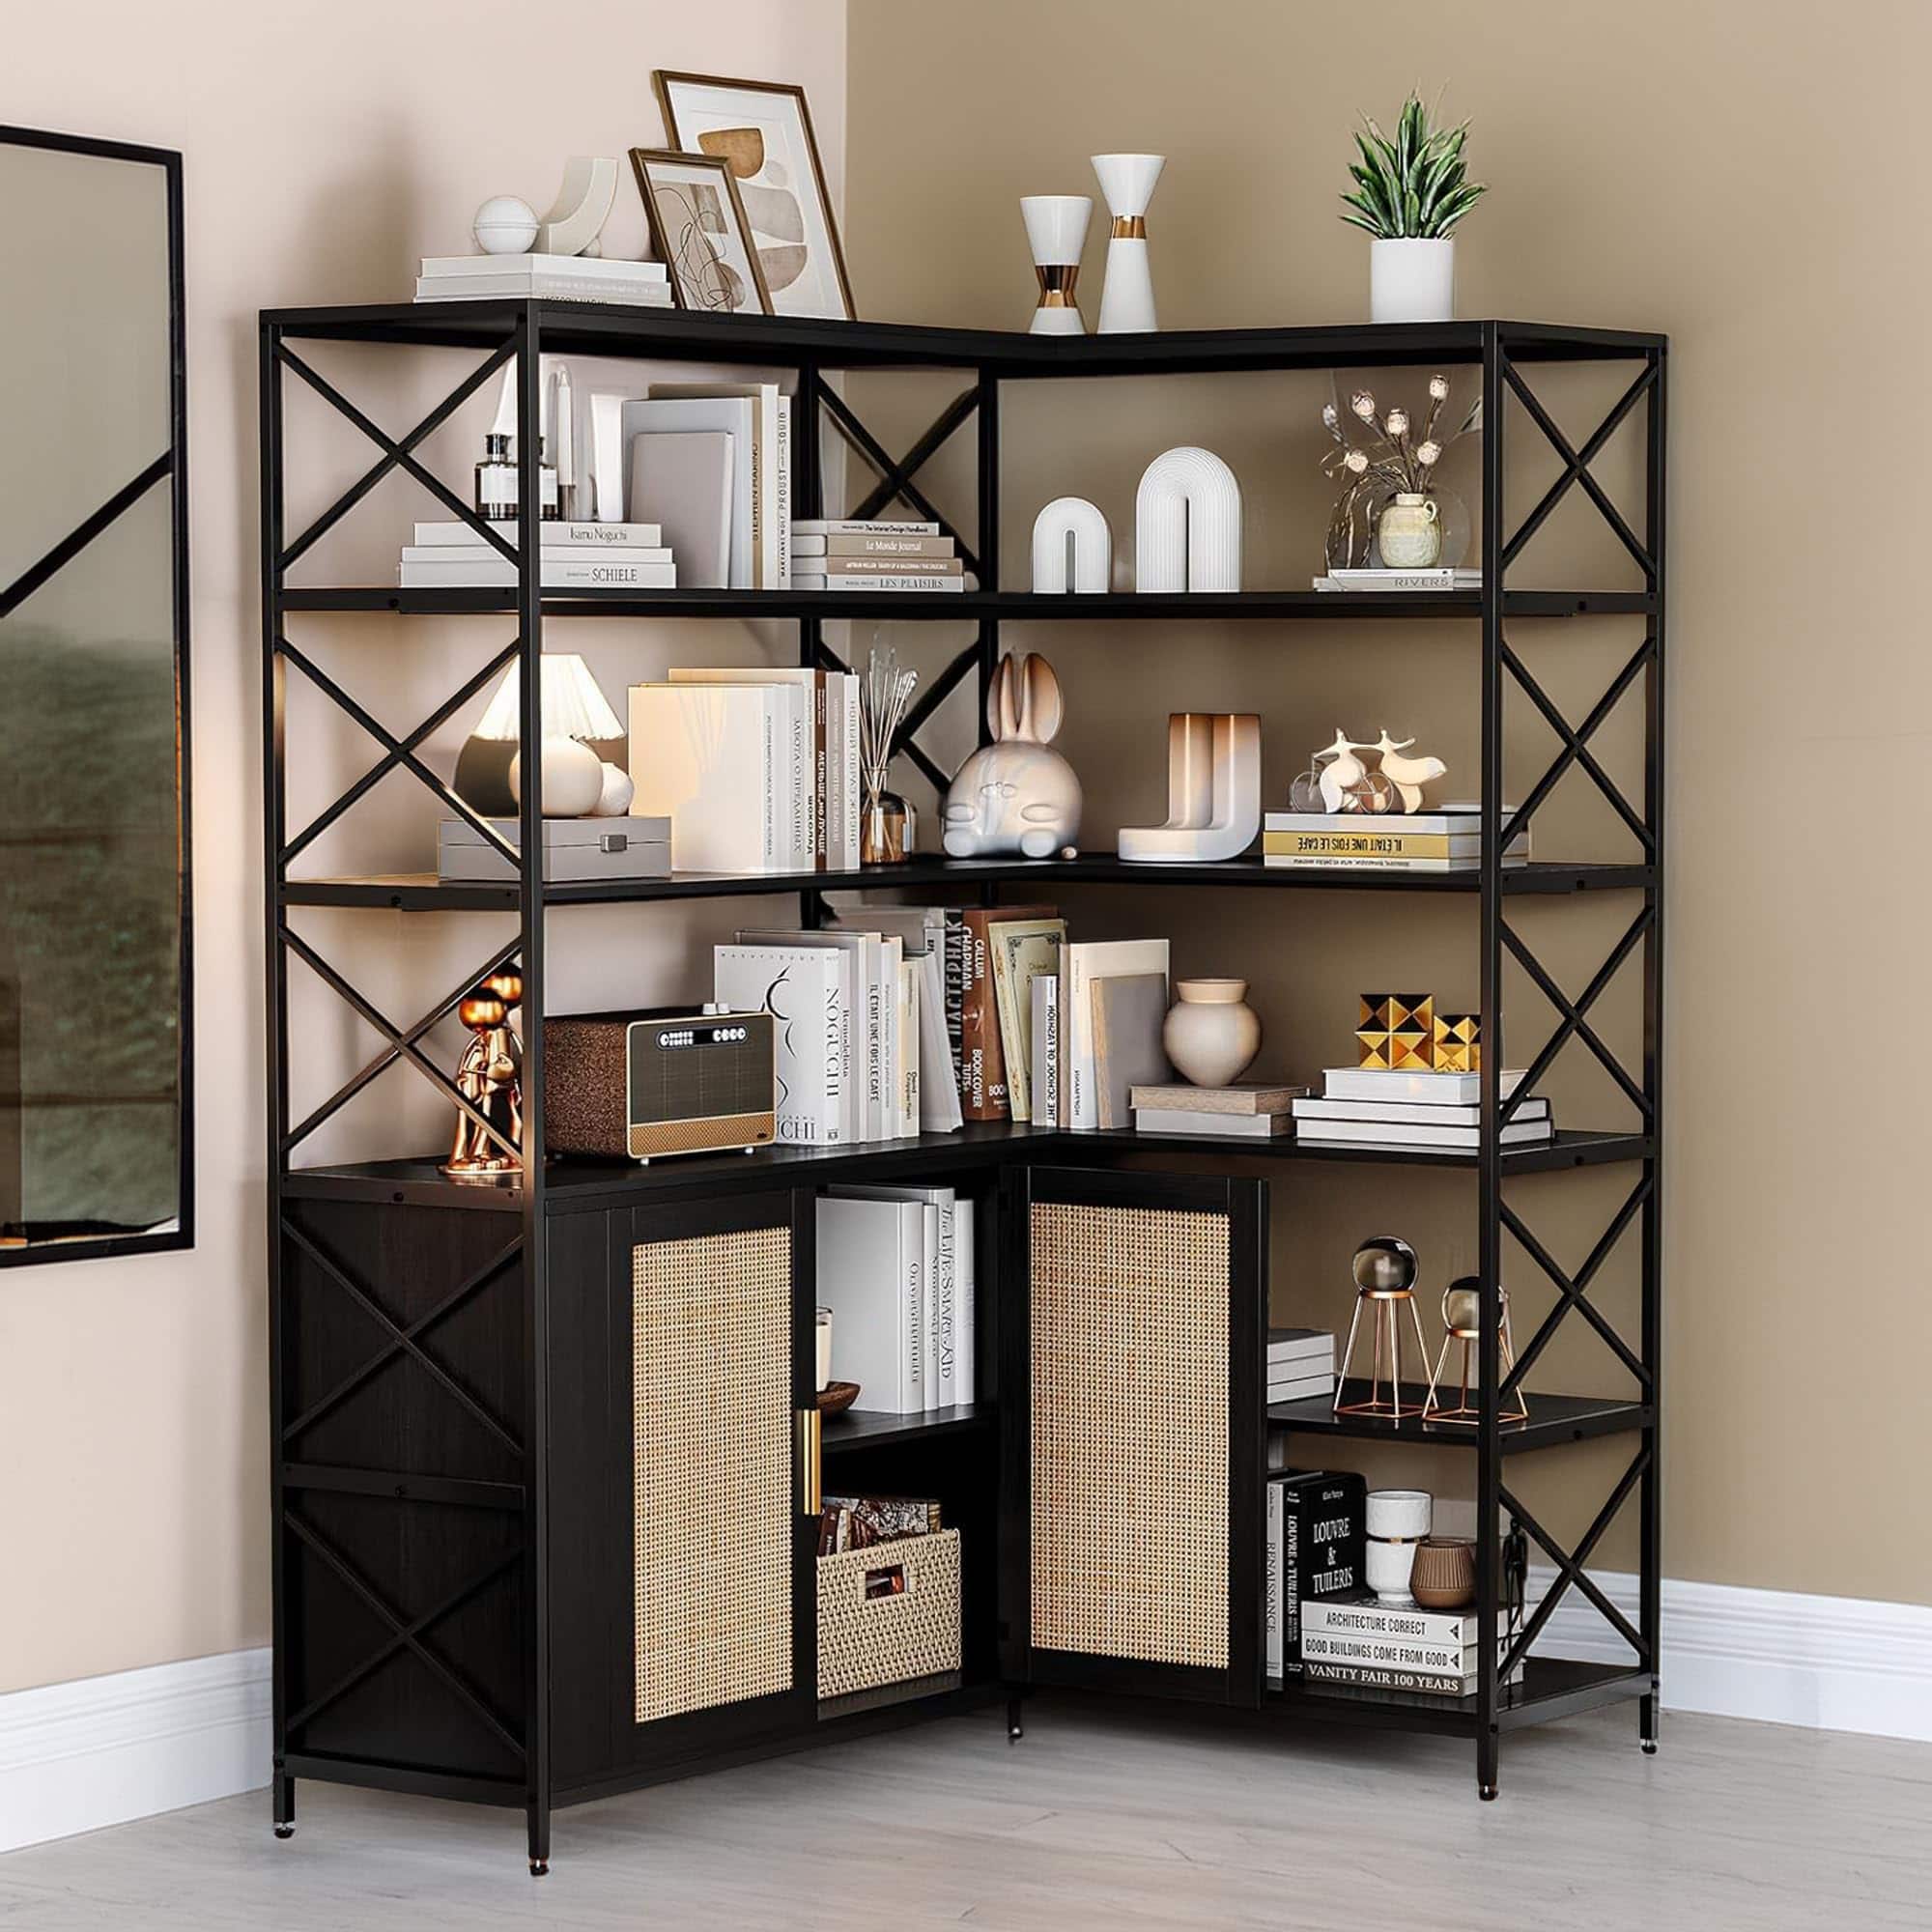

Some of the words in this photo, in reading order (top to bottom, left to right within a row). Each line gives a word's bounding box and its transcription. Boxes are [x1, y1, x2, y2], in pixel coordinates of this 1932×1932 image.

[595, 527, 627, 543] Noguchi
[591, 568, 638, 582] SCHIELE
[881, 580, 896, 588] LES
[900, 580, 943, 588] PLAISIRS
[1395, 579, 1449, 587] RIVERS
[1320, 837, 1331, 850] LE
[1332, 838, 1350, 850] FOIS
[1352, 838, 1368, 850] UNE
[1395, 838, 1403, 850] IL
[962, 926, 973, 991] CHAPMAN
[974, 939, 984, 979] CALLUM
[870, 984, 879, 993] IL
[827, 989, 838, 1095] NOGUCHI
[870, 1022, 879, 1041] UNE
[870, 1043, 879, 1064] FOIS
[972, 1049, 983, 1076] BOOK
[870, 1065, 879, 1076] LE
[972, 1076, 983, 1107] COVER
[1287, 1515, 1298, 1557] LOUVRE
[1313, 1517, 1350, 1544] LOUVRE
[1326, 1547, 1337, 1566] &
[1267, 1542, 1276, 1633] RENAISSANCE
[1312, 1567, 1353, 1596] TUILERIS
[1325, 1611, 1385, 1633] ARCHITECTURE
[1388, 1617, 1426, 1635] CORRECT
[1306, 1638, 1328, 1653] GOOD
[1329, 1641, 1372, 1660] BUILDINGS
[1374, 1646, 1397, 1662] COME
[1399, 1648, 1424, 1664] FROM
[1426, 1652, 1447, 1666] GOOD
[1308, 1663, 1358, 1681] VANITY
[1360, 1669, 1390, 1685] FAIR
[1395, 1673, 1413, 1687] 100
[1415, 1676, 1460, 1692] YEARS
